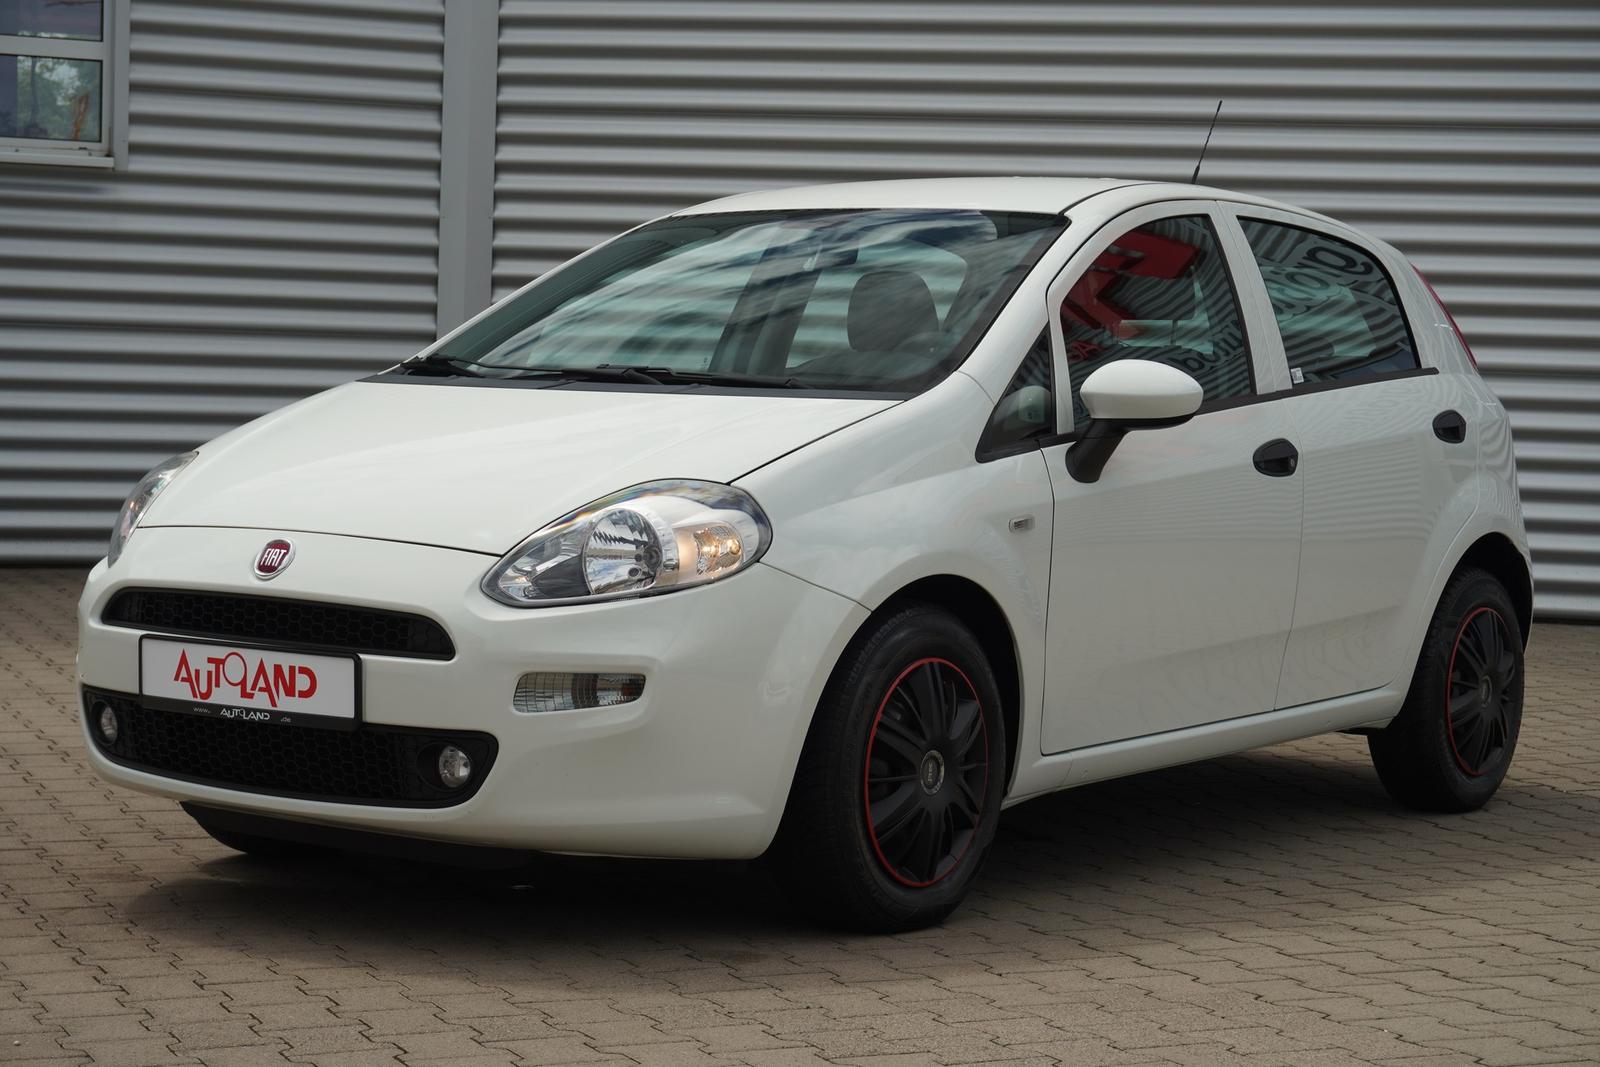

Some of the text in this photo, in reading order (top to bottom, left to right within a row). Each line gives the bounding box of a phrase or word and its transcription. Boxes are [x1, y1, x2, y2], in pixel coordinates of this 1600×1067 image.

[260, 548, 287, 567] FIAT
[173, 648, 318, 708] AUTOLAND
[220, 708, 271, 721] AUTOLAND
